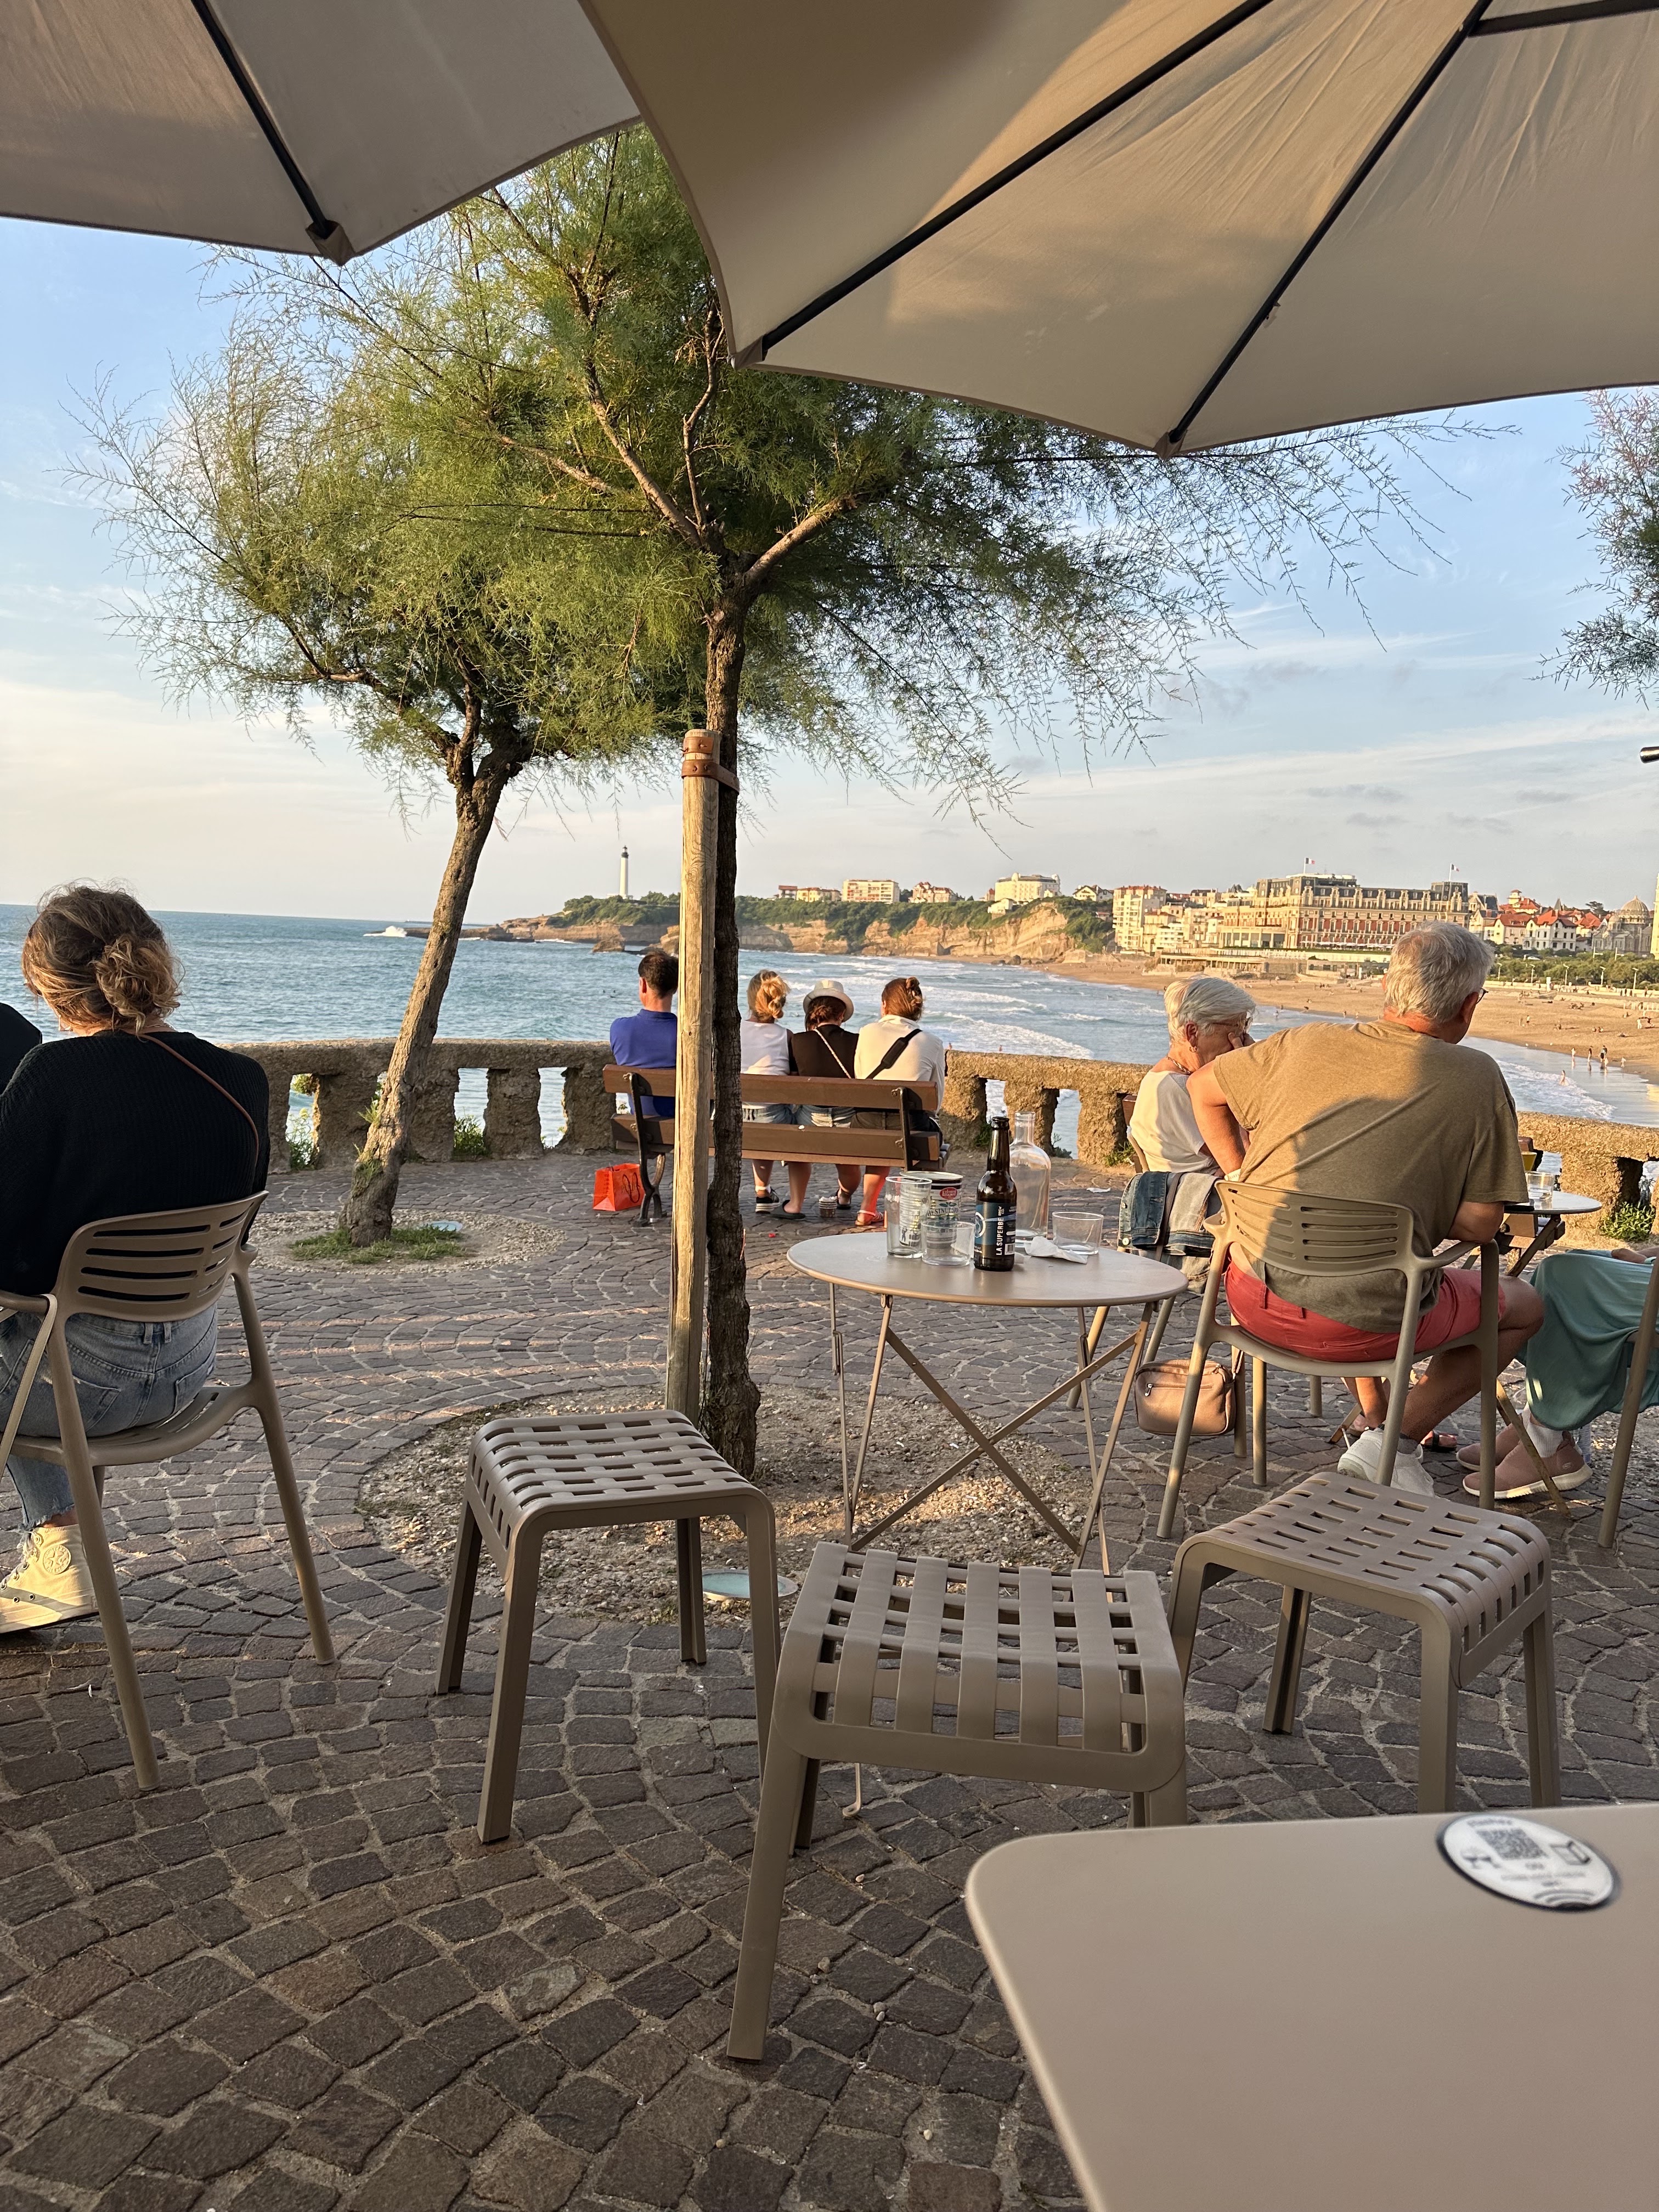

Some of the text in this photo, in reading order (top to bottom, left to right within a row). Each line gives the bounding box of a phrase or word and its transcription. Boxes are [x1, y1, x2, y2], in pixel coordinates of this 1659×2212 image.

[927, 1207, 951, 1216] HESTNUT
[996, 1217, 1004, 1256] LA SUPERBE
